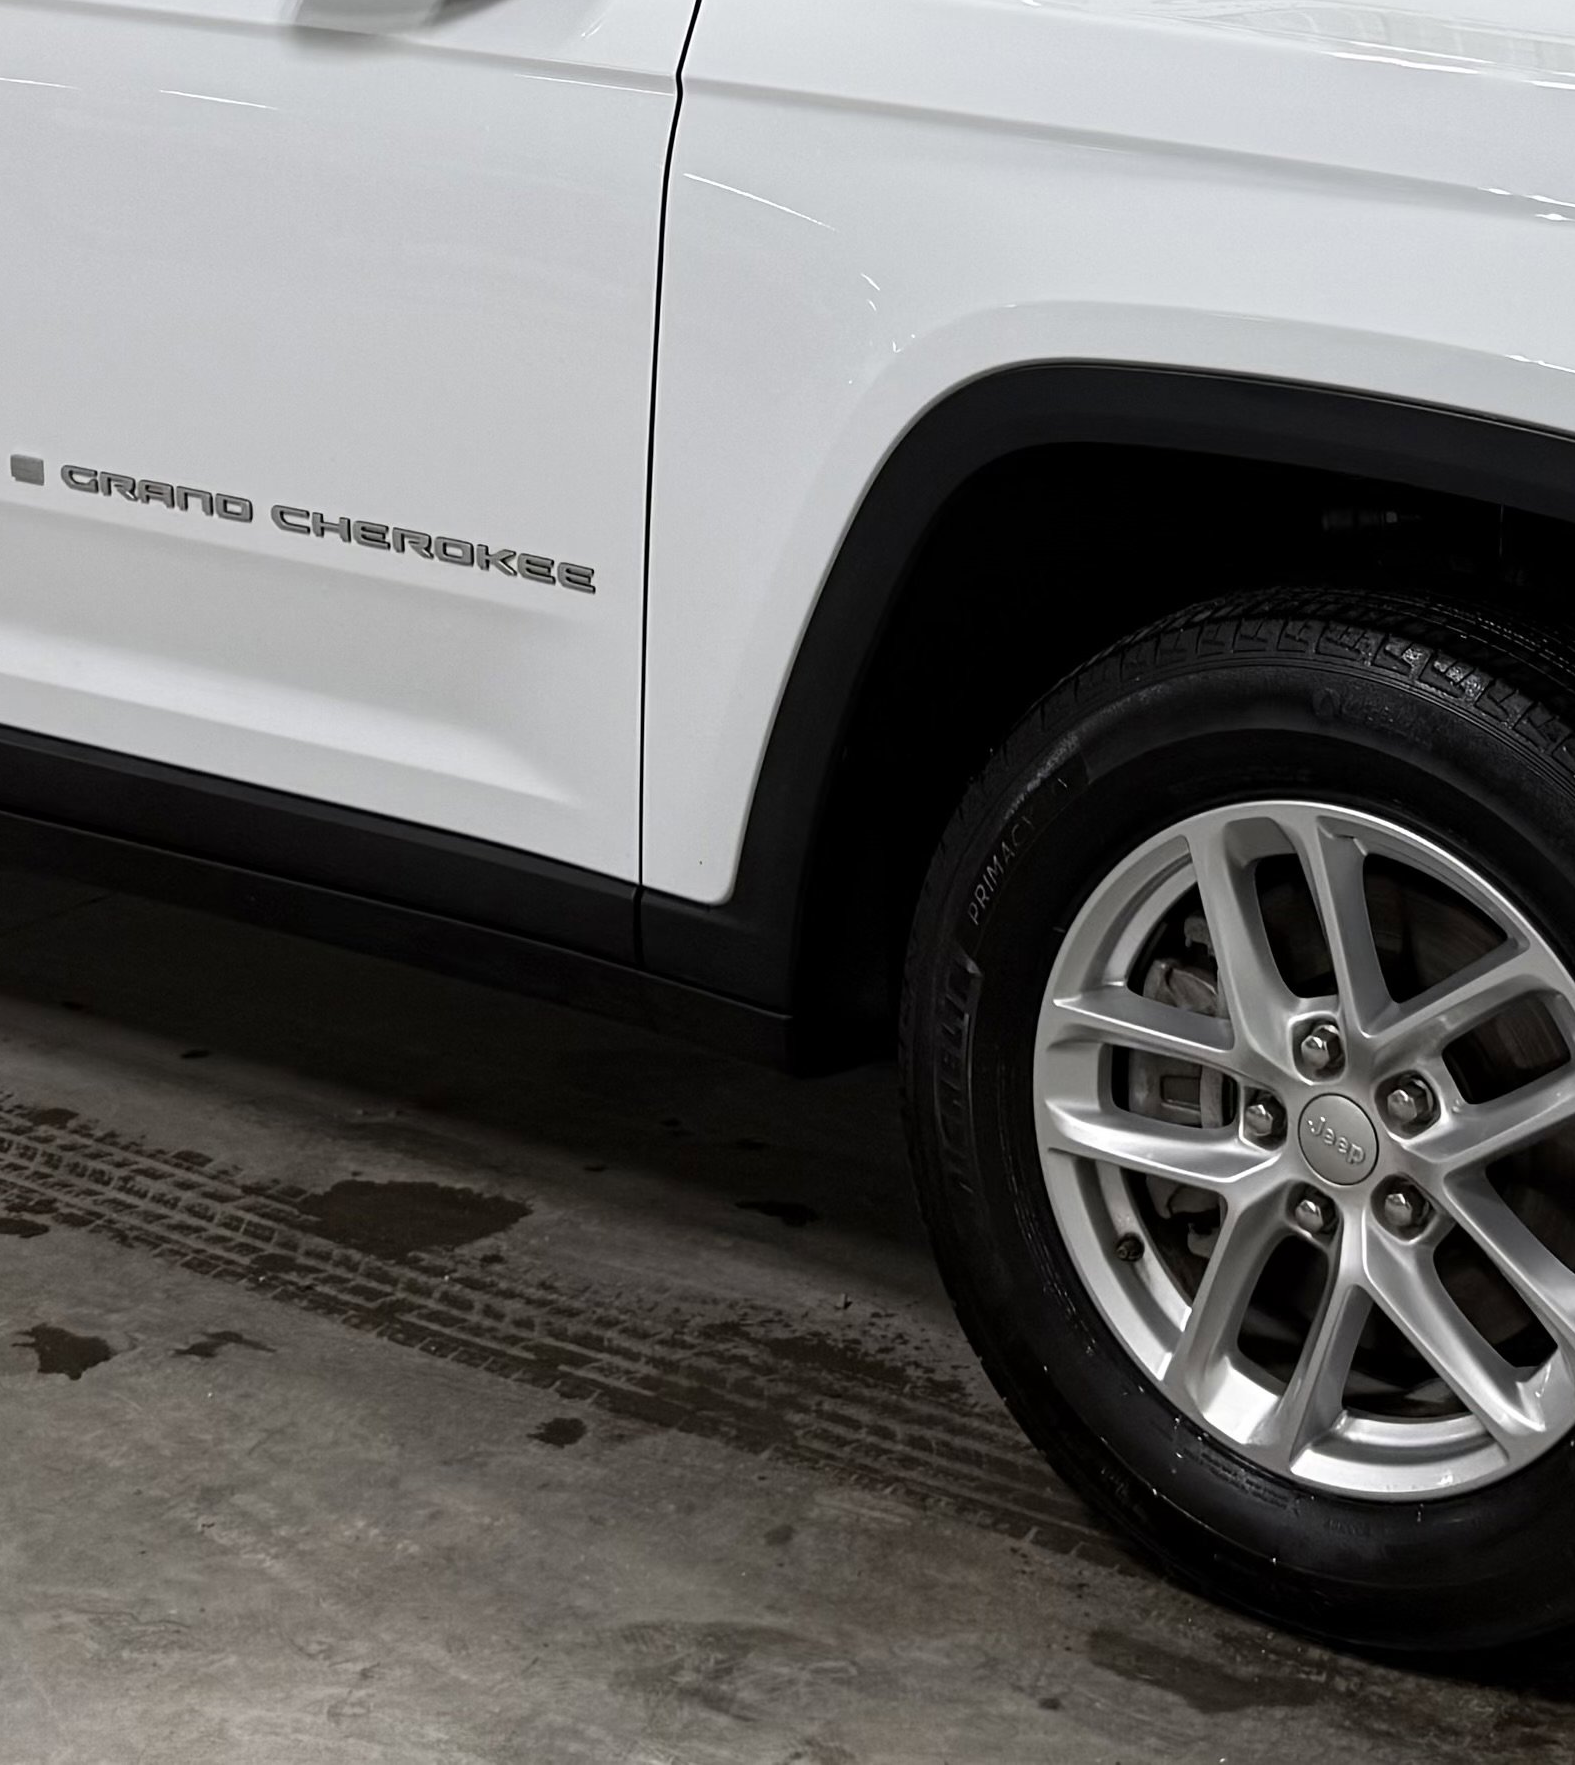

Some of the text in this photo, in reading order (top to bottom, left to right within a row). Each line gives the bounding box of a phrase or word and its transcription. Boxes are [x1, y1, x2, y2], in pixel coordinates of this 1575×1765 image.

[60, 463, 597, 594] GRAND CHEROKEE
[1307, 1115, 1366, 1165] Jeep
